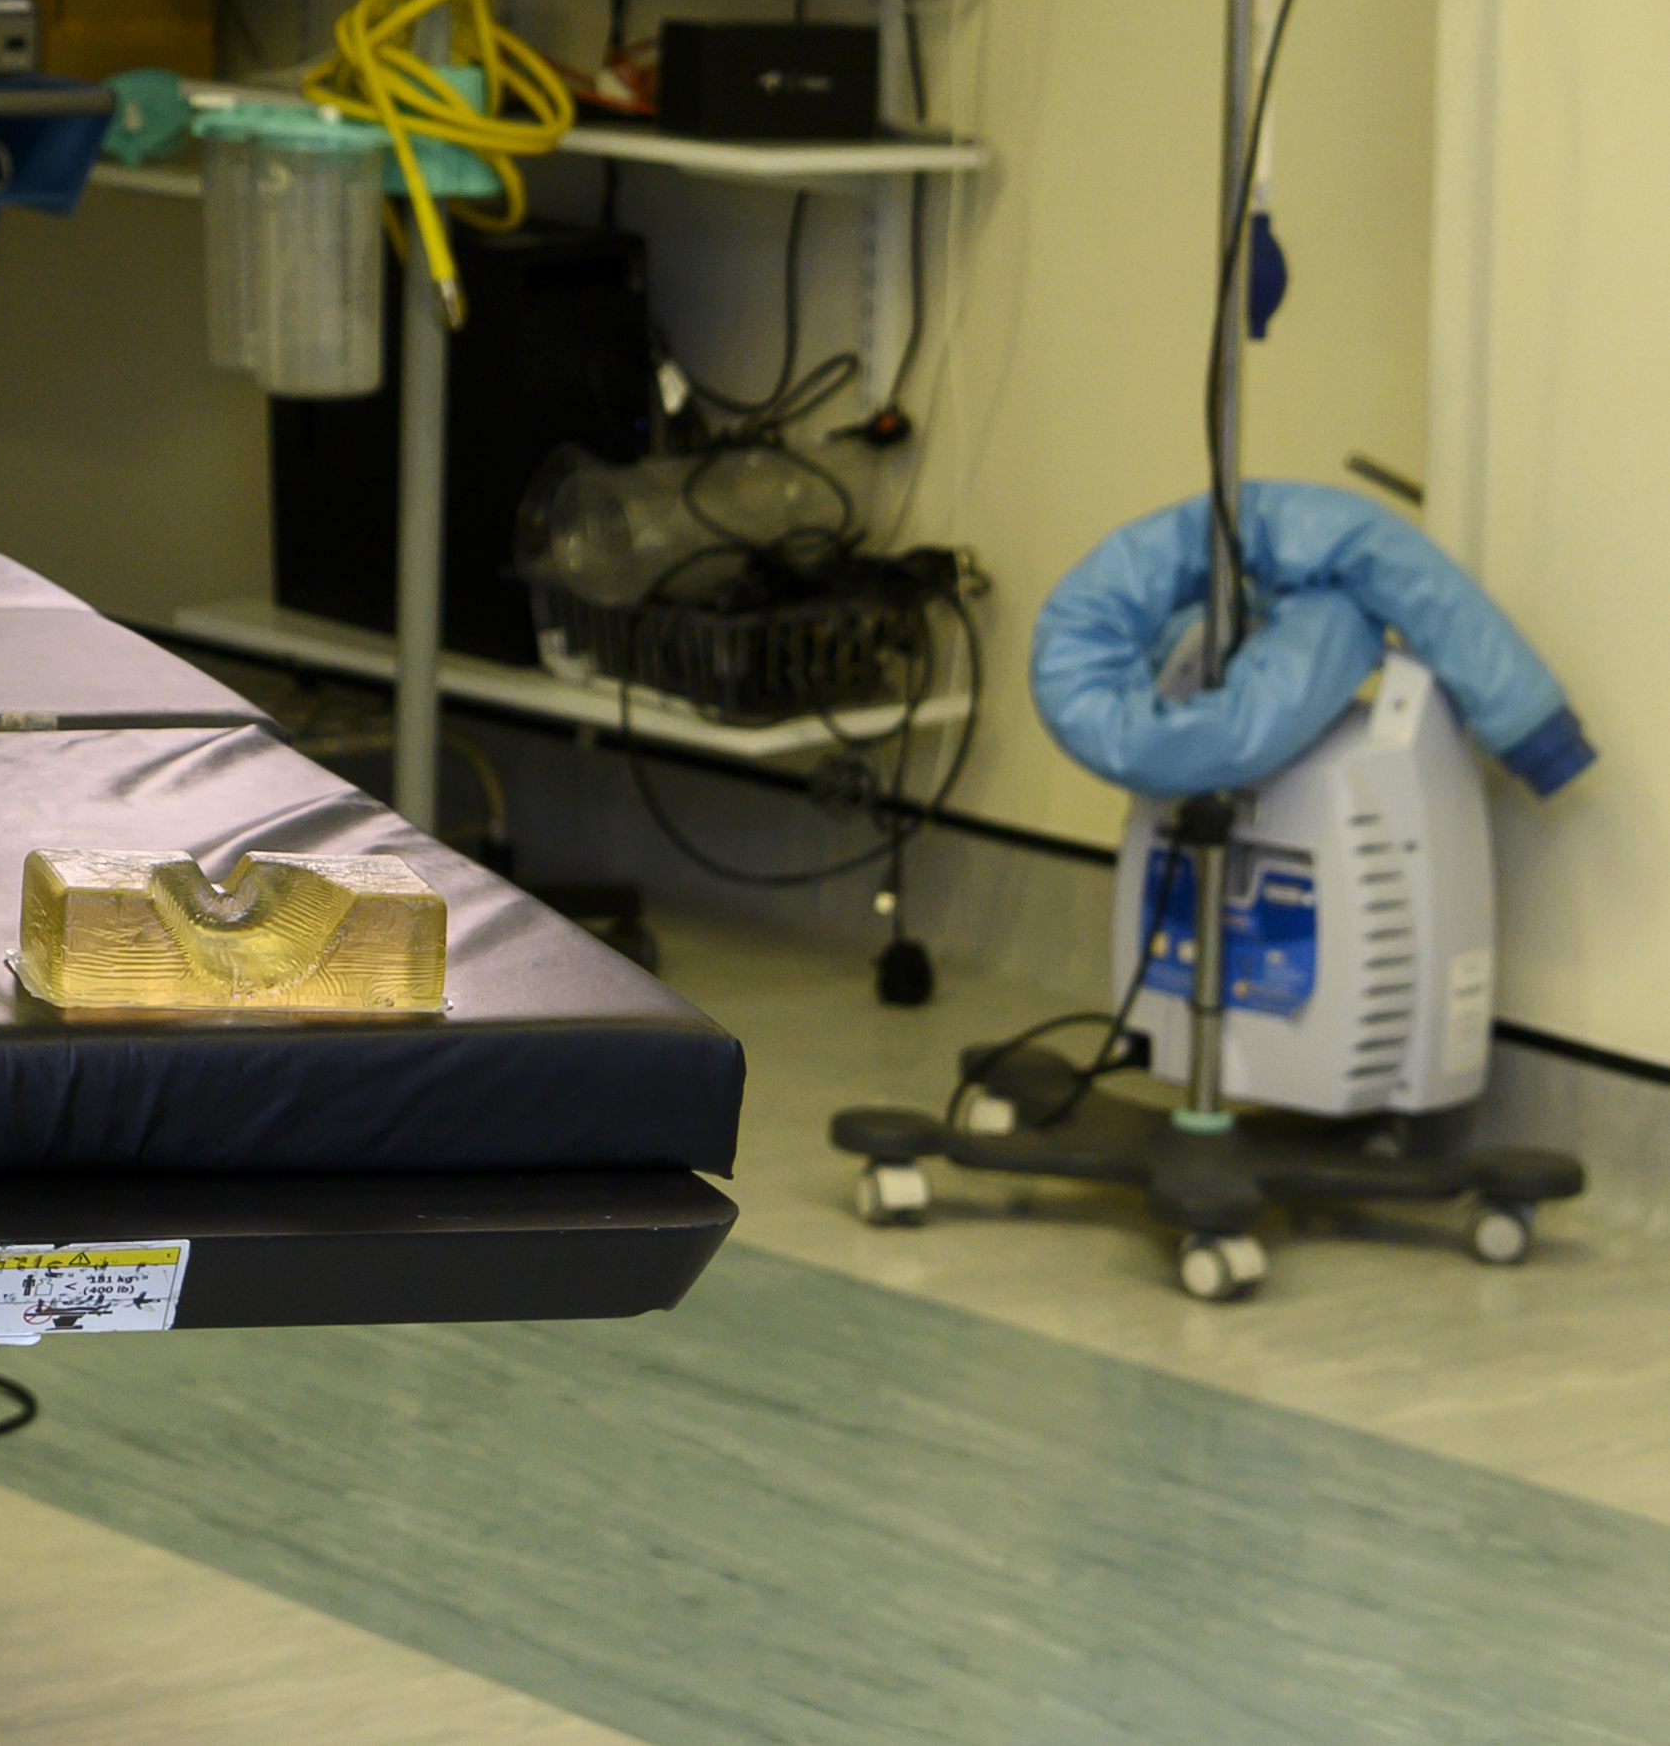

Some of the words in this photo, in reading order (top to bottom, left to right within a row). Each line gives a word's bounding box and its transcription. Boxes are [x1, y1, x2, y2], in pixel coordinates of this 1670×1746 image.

[91, 1275, 112, 1284] 181
[117, 1275, 134, 1284] kg
[83, 1285, 113, 1295] (400
[117, 1285, 134, 1294] lb)
